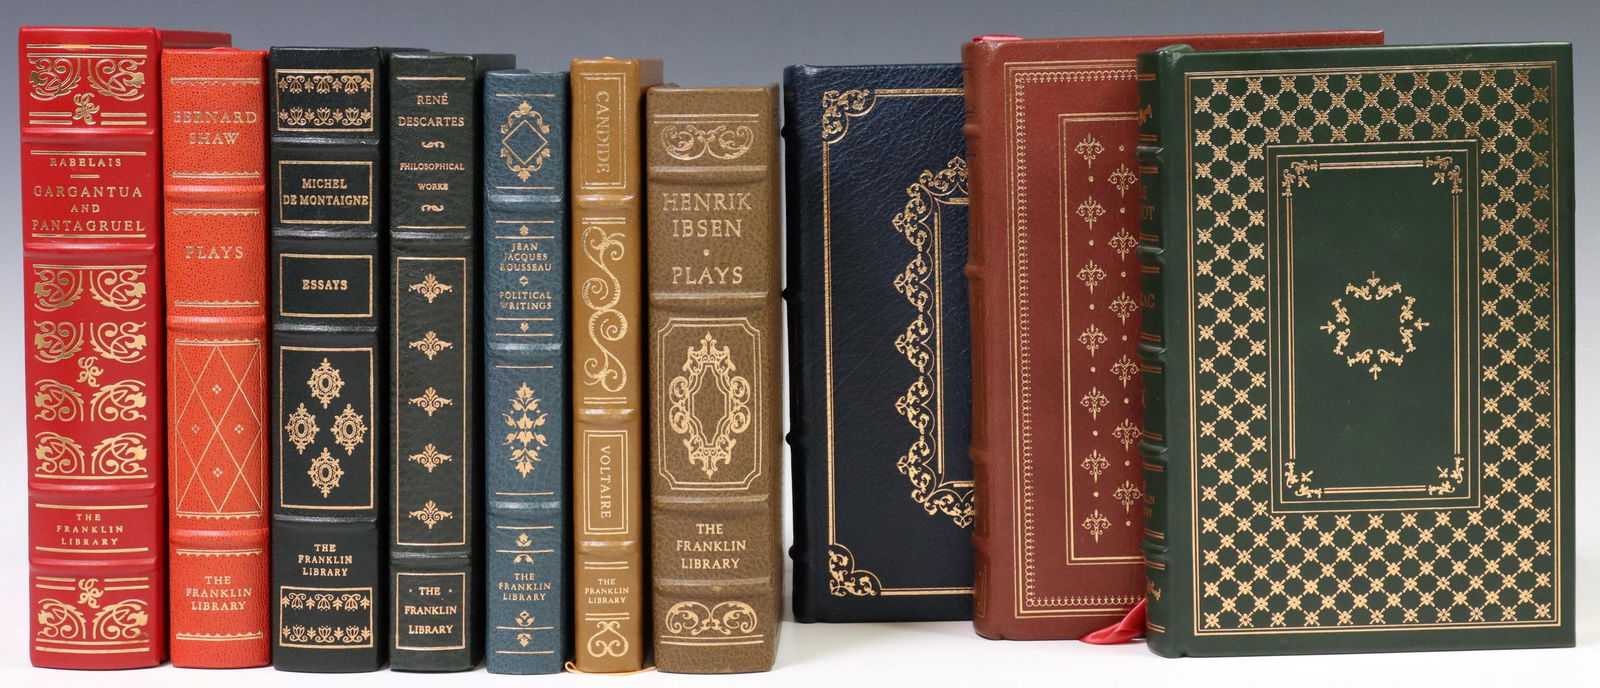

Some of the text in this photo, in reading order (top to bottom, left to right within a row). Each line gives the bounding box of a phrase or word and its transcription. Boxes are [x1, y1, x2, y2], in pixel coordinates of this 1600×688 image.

[416, 93, 449, 105] RENÉ
[173, 111, 258, 124] BERNARD
[398, 116, 465, 127] DESCARTES
[596, 90, 610, 173] CANDIDE
[188, 132, 240, 145] SHAW
[50, 158, 122, 167] RABELAIS
[400, 163, 465, 171] PHILOSOPHICAL
[302, 178, 348, 189] MICHEL
[417, 183, 449, 191] WORKS
[33, 186, 143, 198] GARGANTUA
[283, 195, 369, 206] DE MONTAIGNE
[662, 192, 752, 211] HENRIK
[70, 204, 100, 213] AND
[32, 220, 145, 232] PANTAGRUEL
[673, 219, 742, 237] IBSEN
[185, 246, 244, 259] PLAYS
[511, 243, 538, 252] JEAN
[504, 253, 548, 262] JACQUES
[500, 264, 552, 272] ROUSSEAU
[672, 266, 743, 284] PLAYS
[302, 280, 348, 291] ESSAYS
[500, 291, 552, 299] POLITICAL
[500, 302, 552, 310] WRITINGS
[600, 445, 611, 519] VOLTAIRE
[76, 513, 101, 521] THE
[56, 525, 124, 533] FRANKLIN
[696, 523, 723, 535] THE
[61, 537, 119, 546] LIBRARY
[676, 540, 747, 552] FRANKLIN
[314, 544, 337, 552] THE
[298, 554, 353, 564] FRANKLIN
[681, 558, 740, 569] LIBRARY
[302, 567, 349, 577] LIBRARY
[514, 572, 535, 581] THE
[205, 576, 231, 585] THE
[598, 578, 616, 586] THE
[419, 586, 441, 596] THE
[498, 582, 551, 591] FRANKLIN
[585, 587, 629, 595] FRANKLIN
[185, 588, 252, 598] FRANKLIN
[503, 593, 546, 601] LIBRARY
[191, 601, 246, 611] LIBRARY
[404, 605, 457, 615] FRANKLIN
[408, 625, 453, 635] LIBRARY
